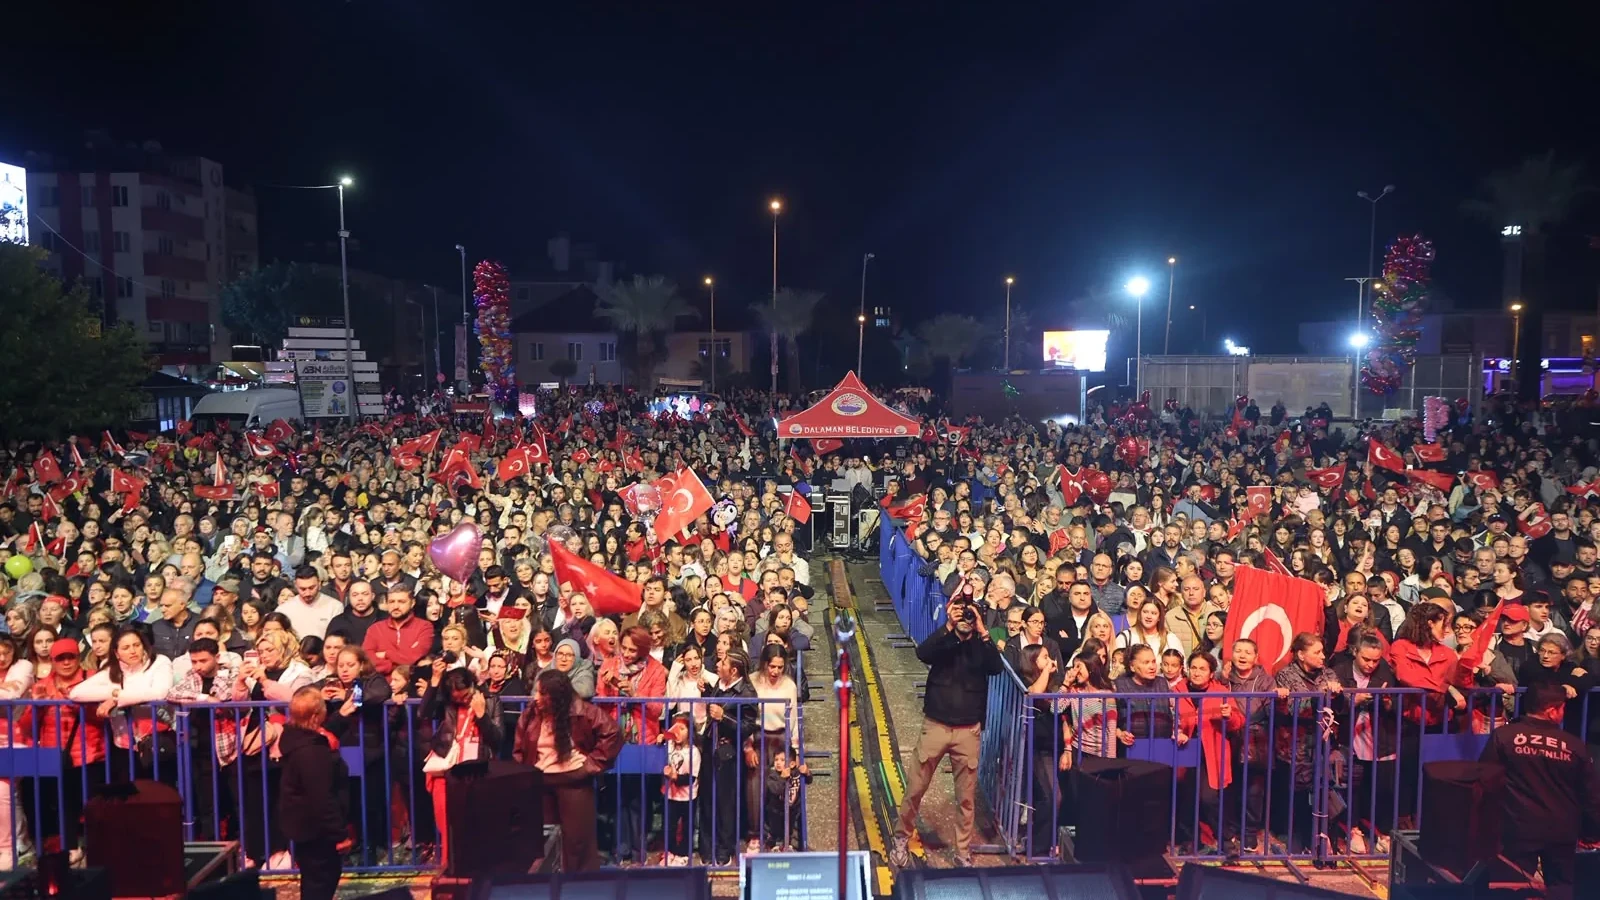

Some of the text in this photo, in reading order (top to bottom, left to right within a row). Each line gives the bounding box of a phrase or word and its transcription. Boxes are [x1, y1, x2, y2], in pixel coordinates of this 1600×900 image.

[302, 365, 322, 374] ABN
[804, 426, 844, 434] DALAMAN
[1513, 733, 1572, 754] ÖZEL
